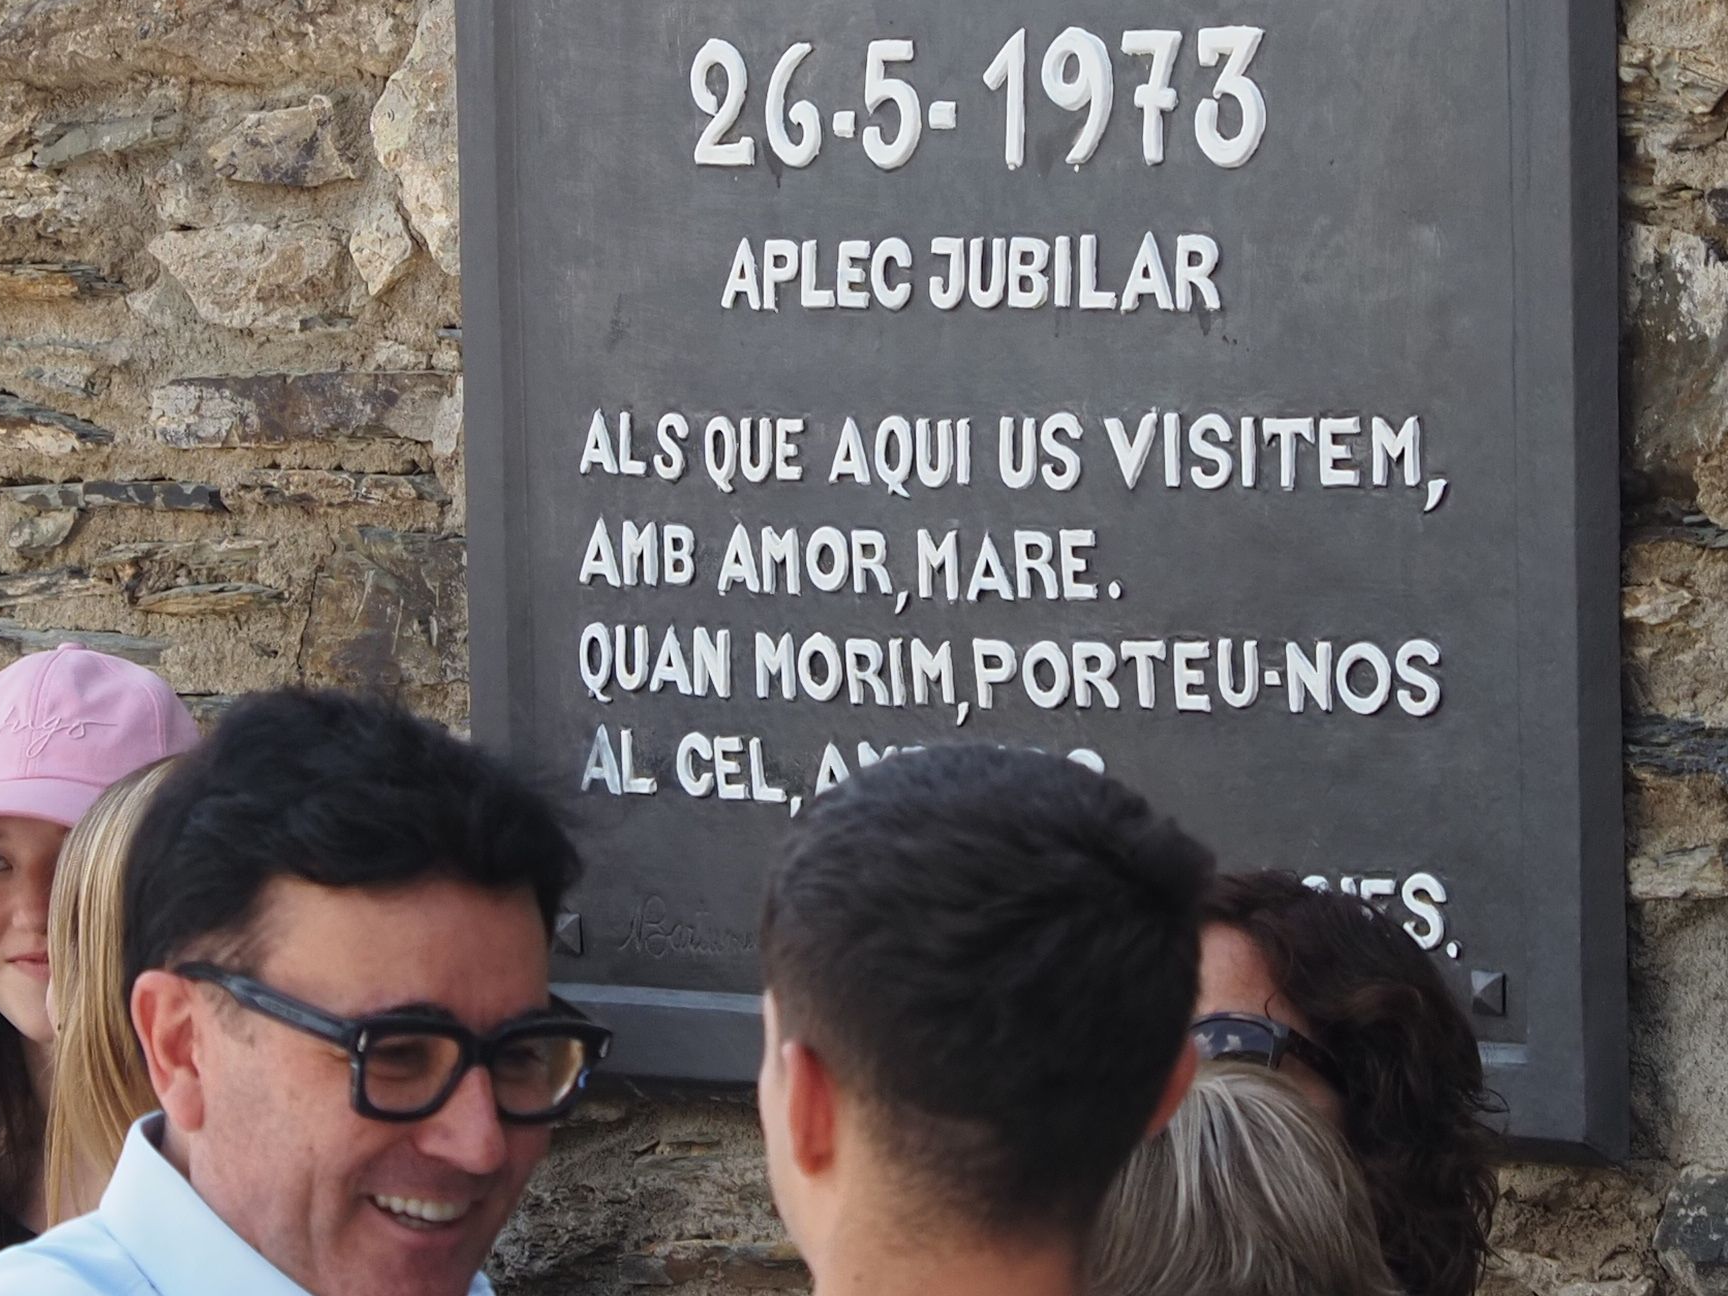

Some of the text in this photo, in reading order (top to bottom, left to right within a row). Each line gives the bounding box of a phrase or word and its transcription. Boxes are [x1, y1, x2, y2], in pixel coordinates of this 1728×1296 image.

[721, 231, 1220, 314] APLEC JUBILAR
[580, 406, 1447, 510] ALS QUE AQUI US VISITEM,
[579, 517, 694, 587] AMB
[580, 622, 730, 702] QUAN
[582, 724, 657, 795] AL
[677, 732, 802, 817] CEL,
